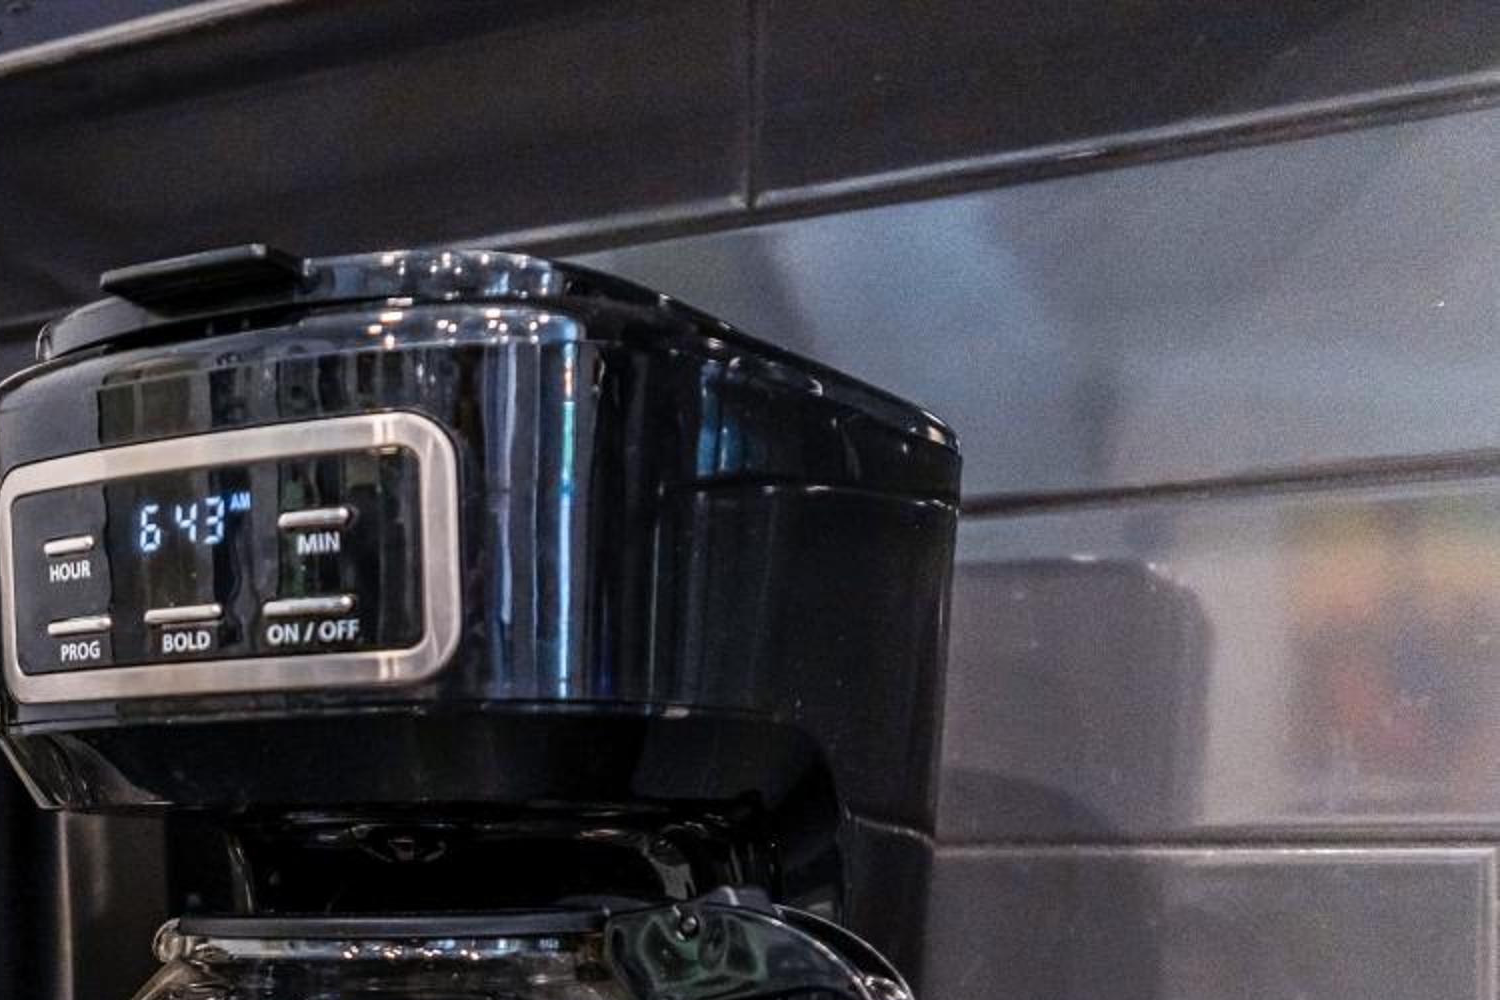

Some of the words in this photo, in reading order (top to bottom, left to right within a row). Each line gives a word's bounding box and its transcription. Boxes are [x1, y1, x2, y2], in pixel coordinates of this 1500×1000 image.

[229, 491, 251, 512] AM
[297, 531, 341, 555] MIN
[49, 560, 92, 582] HOUR
[162, 631, 211, 653] BOLD
[267, 624, 299, 644] ON
[318, 618, 360, 641] OFF
[60, 640, 101, 662] PROG
